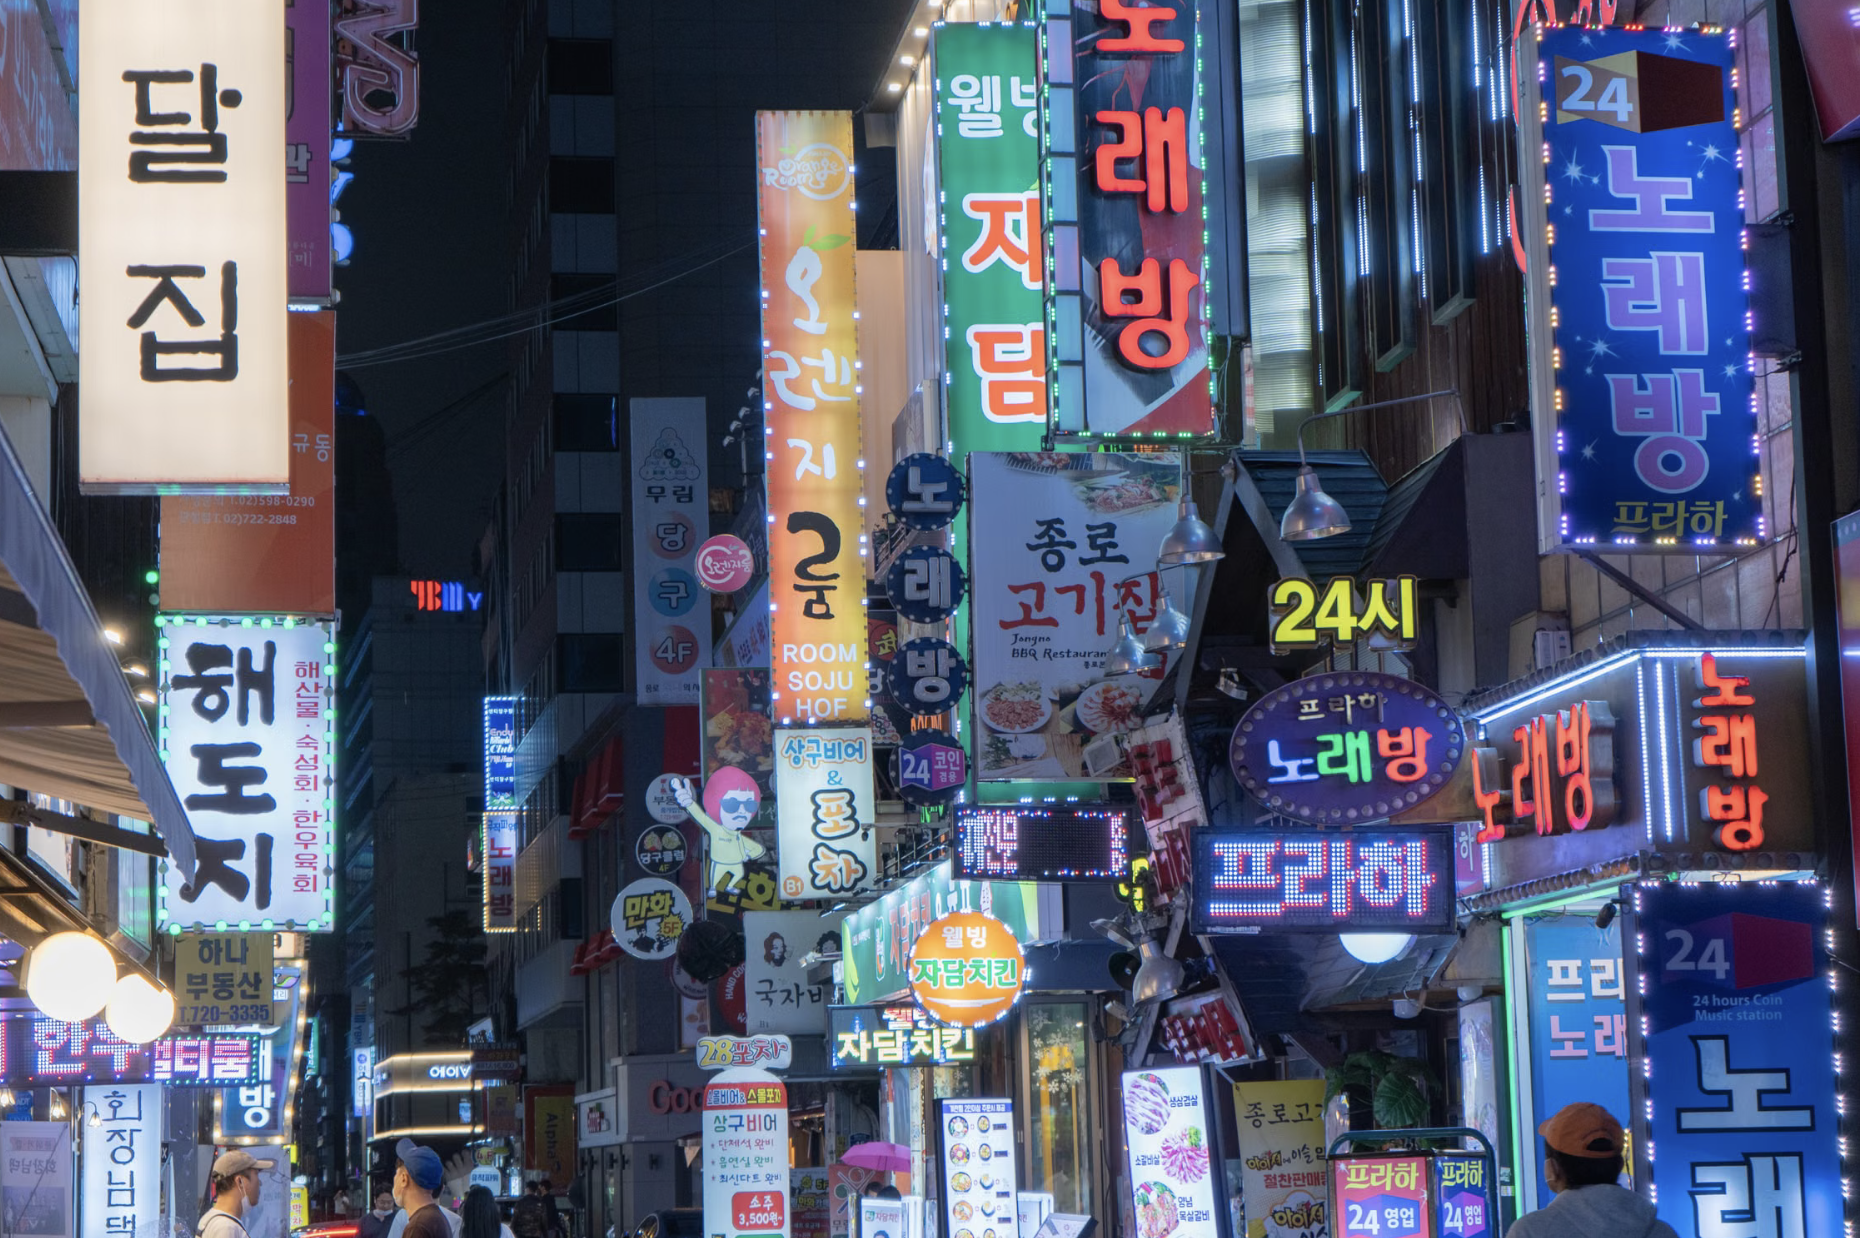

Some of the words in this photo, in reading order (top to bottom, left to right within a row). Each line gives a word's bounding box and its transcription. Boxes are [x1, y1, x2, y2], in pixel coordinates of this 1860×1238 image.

[1561, 66, 1633, 122] 24
[1096, 0, 1199, 369] 노래방
[1589, 144, 1721, 494] 노래방
[646, 485, 694, 503] 무림
[1613, 500, 1728, 538] 프라하
[1026, 517, 1130, 573] 종로
[704, 550, 751, 574] 오렌지룸
[902, 466, 956, 701] 노래방
[999, 571, 1160, 636] 고기집
[1274, 578, 1415, 642] 24시
[656, 637, 694, 664] 4F
[784, 644, 858, 663] ROOM
[1011, 633, 1051, 647] Jongno
[1011, 648, 1038, 661] BBQ
[788, 672, 853, 692] SOJU
[796, 698, 847, 718] HOF
[1298, 691, 1388, 724] 프라하
[783, 737, 865, 767] 상구비어
[934, 750, 960, 771] 코인
[1267, 726, 1433, 783] 노래방
[1701, 652, 1768, 851] 노래방
[170, 640, 277, 910] 해도지
[827, 770, 843, 785] &
[903, 753, 930, 785] 24
[1472, 700, 1594, 843] 노래방
[813, 791, 865, 891] 포차
[640, 850, 684, 864] 당구클럽
[659, 864, 670, 873] 4F
[488, 837, 513, 917] 노래방
[785, 879, 802, 894] B1
[1210, 841, 1436, 916] 프라하
[624, 890, 673, 928] 만화
[663, 922, 680, 934] 5F
[942, 926, 987, 948] 웰빙
[198, 938, 249, 966] 하나
[1665, 929, 1730, 979] 24
[186, 972, 262, 1001] 부동산
[914, 958, 1018, 988] 자담치킨
[724, 977, 737, 1000] HAND
[1693, 995, 1710, 1007] 24
[1712, 994, 1750, 1006] hours
[1753, 994, 1783, 1006] Coin
[180, 1004, 269, 1023] T.720-3335
[1695, 1009, 1733, 1021] Music
[1736, 1009, 1783, 1021] station
[836, 1028, 974, 1062] 자담치킨
[1549, 1014, 1628, 1060] 노래
[699, 1039, 789, 1067] 28포차
[545, 1112, 558, 1160] Alpha
[713, 1114, 777, 1133] 상구비어
[718, 1139, 752, 1152] 단체석
[754, 1138, 774, 1150] 완비
[719, 1156, 751, 1169] 흡연실
[754, 1156, 774, 1168] 완비
[1345, 1162, 1420, 1191] 프라하
[1441, 1160, 1484, 1188] 프라하
[719, 1174, 762, 1186] 최신다트
[764, 1173, 782, 1185] 완비
[749, 1195, 774, 1211] 소주
[738, 1212, 783, 1228] 3,500원~
[1348, 1205, 1380, 1236] 24
[1384, 1207, 1415, 1228] 영업
[1444, 1202, 1463, 1233] 24
[1465, 1205, 1482, 1225] 영업
